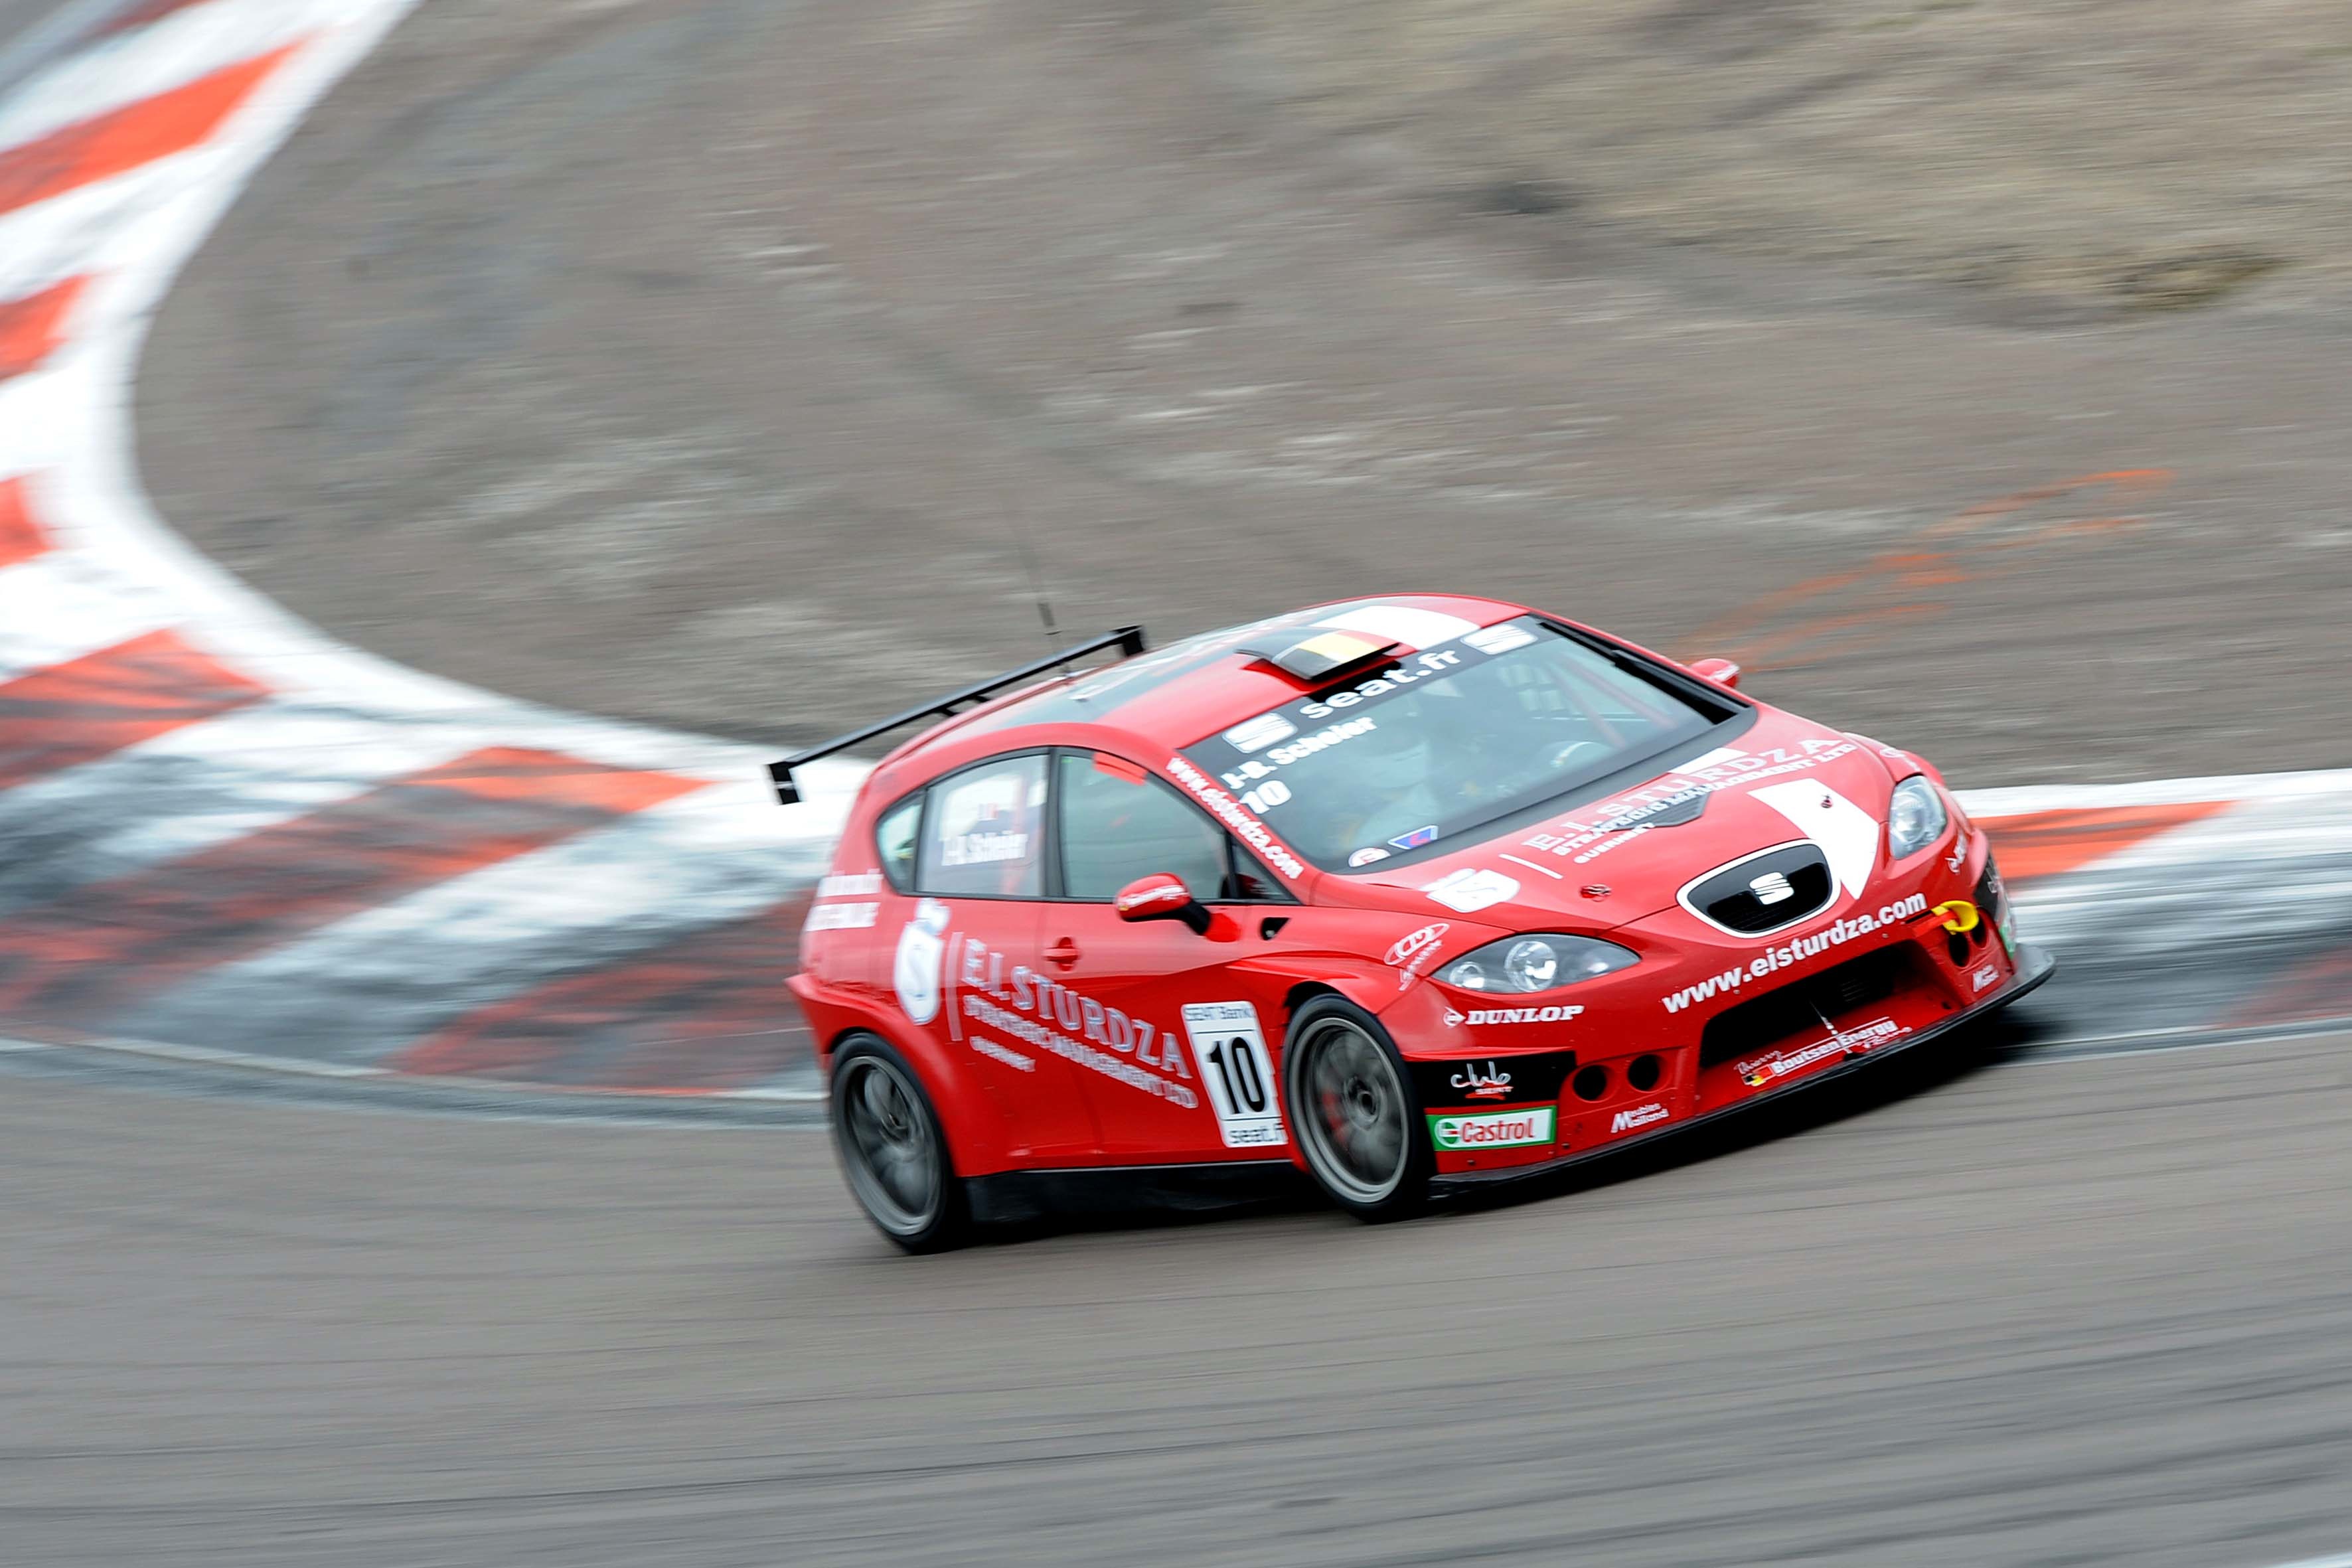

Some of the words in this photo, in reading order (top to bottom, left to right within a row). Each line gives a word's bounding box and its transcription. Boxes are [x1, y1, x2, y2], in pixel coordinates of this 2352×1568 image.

[1299, 650, 1461, 719] seat.fr
[1239, 779, 1292, 814] 10
[1596, 739, 1844, 817] STURDZA
[1662, 893, 1927, 1014] www.eisturdza.com
[1010, 966, 1192, 1079] STURDZA
[1464, 1005, 1585, 1025] DUNLOP
[1206, 1036, 1265, 1115] 10
[1450, 1061, 1512, 1087] club
[1769, 1040, 1841, 1073] Boutsen
[1462, 1118, 1535, 1143] Castrol
